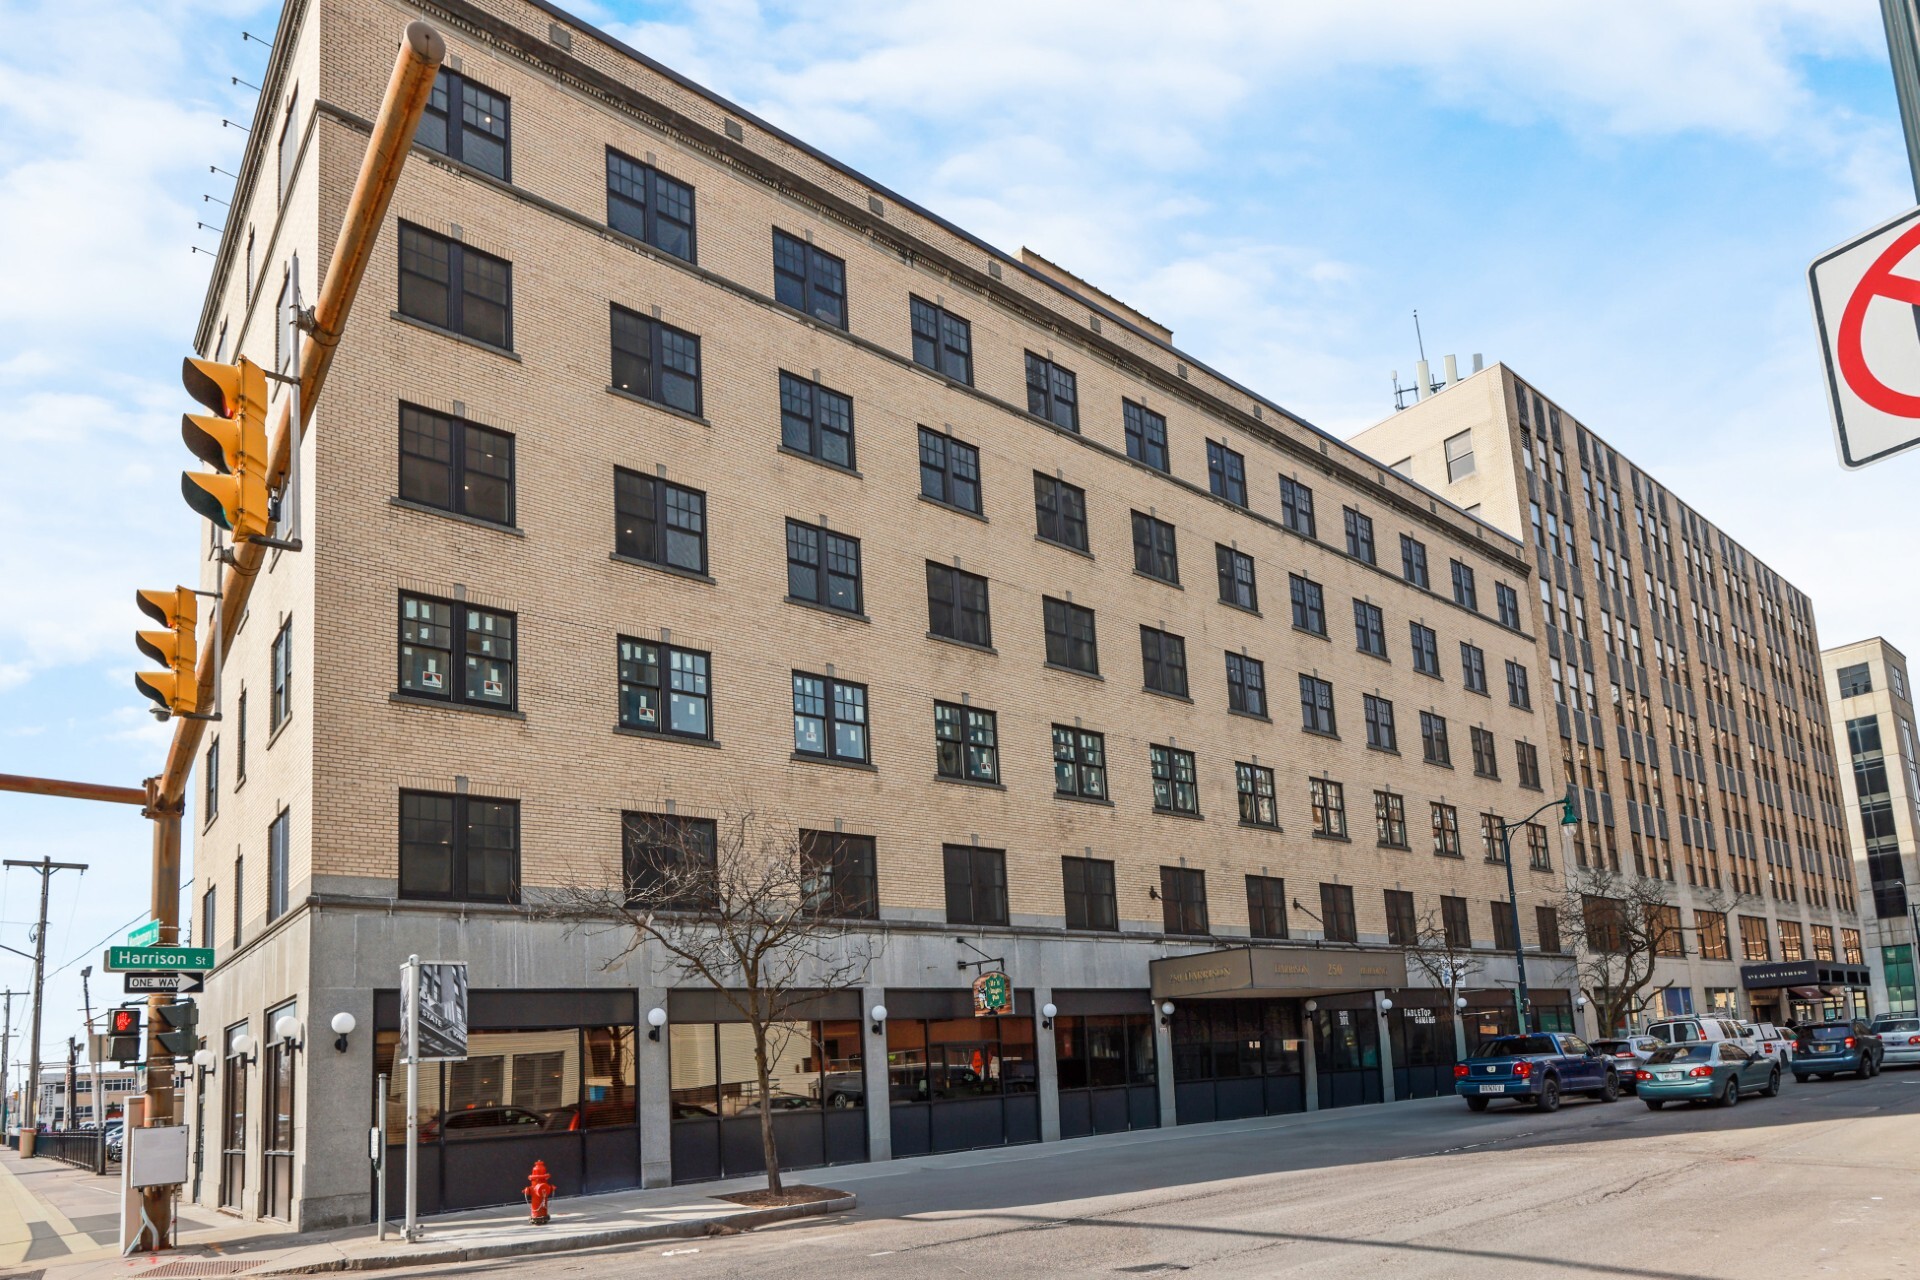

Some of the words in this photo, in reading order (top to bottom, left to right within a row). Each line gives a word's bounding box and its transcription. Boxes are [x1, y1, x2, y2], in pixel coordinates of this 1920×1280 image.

[119, 951, 187, 965] Harrison
[195, 956, 206, 965] St
[1327, 963, 1343, 976] 250
[132, 978, 152, 987] ONE
[158, 978, 180, 987] WAY
[421, 1008, 443, 1028] STATE
